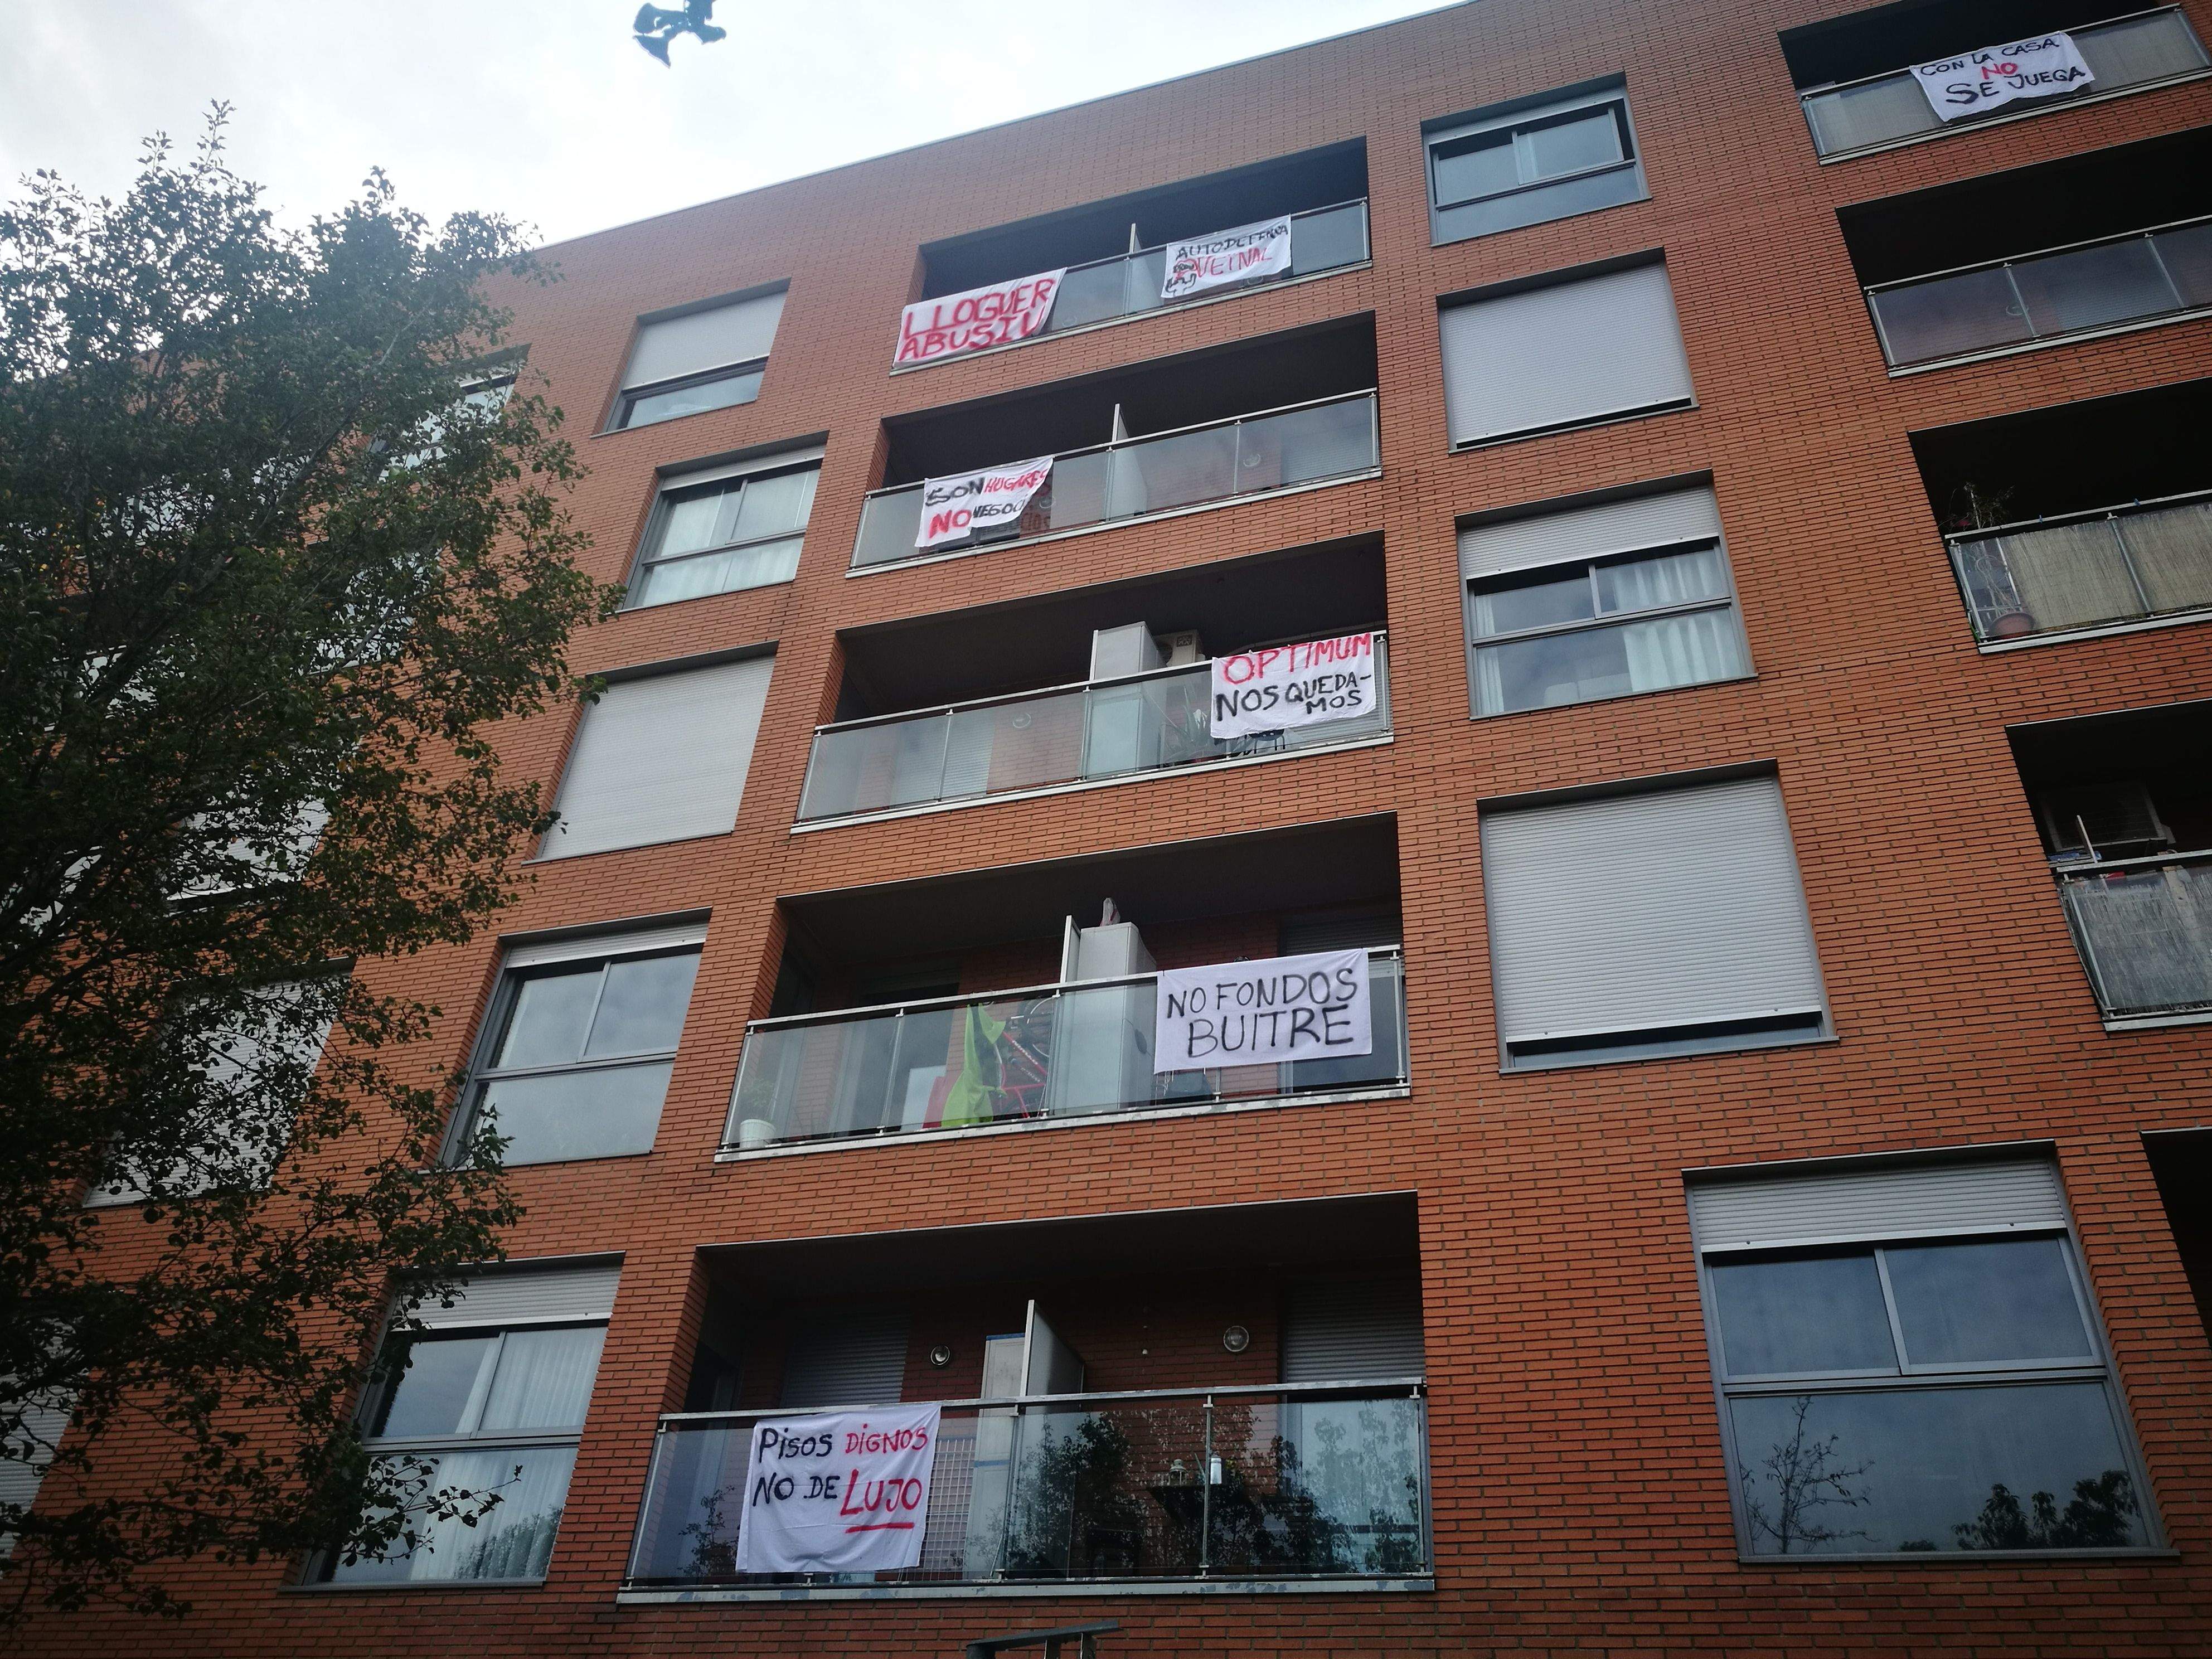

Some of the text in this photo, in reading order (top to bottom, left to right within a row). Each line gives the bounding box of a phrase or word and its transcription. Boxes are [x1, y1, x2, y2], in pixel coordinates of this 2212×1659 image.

[1920, 38, 2060, 76] CON LA CASA
[1981, 62, 2018, 79] NO
[1946, 66, 2085, 105] SE JUEGA
[925, 477, 984, 506] SON
[929, 510, 972, 539] NO
[1224, 632, 1372, 685] OPTIMUM
[1216, 685, 1280, 722] NOS
[1306, 690, 1362, 715] MOS
[1167, 968, 1357, 1018] NO FONDOS
[1188, 1004, 1354, 1058] BUITRE
[753, 1469, 923, 1516] NO DE LUJO
